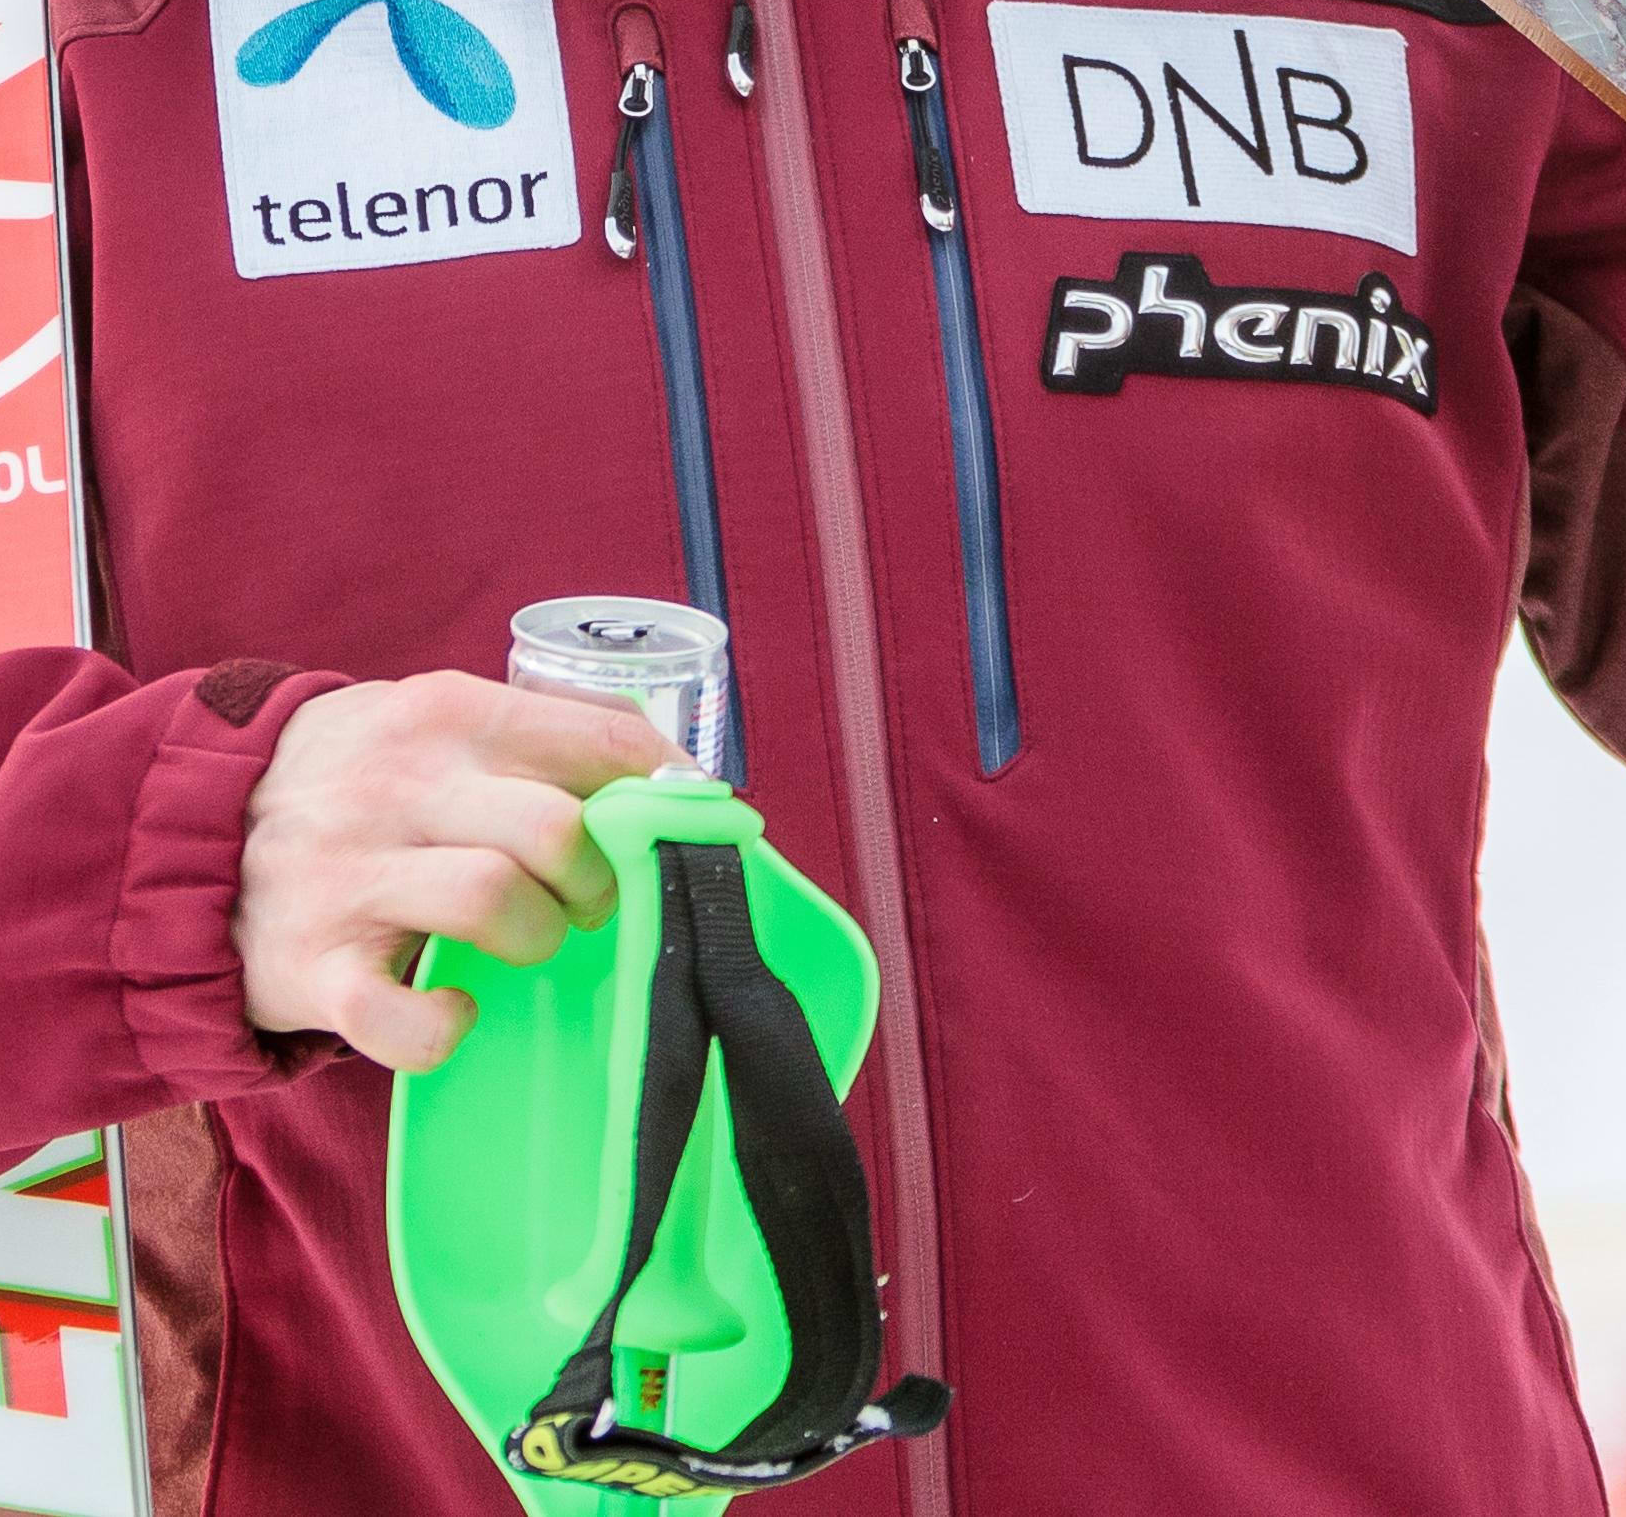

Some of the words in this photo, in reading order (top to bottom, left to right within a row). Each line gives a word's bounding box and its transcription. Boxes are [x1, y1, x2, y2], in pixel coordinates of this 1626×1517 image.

[1061, 28, 1369, 207] DNB
[252, 170, 549, 246] telenor
[1051, 264, 1431, 398] phenix
